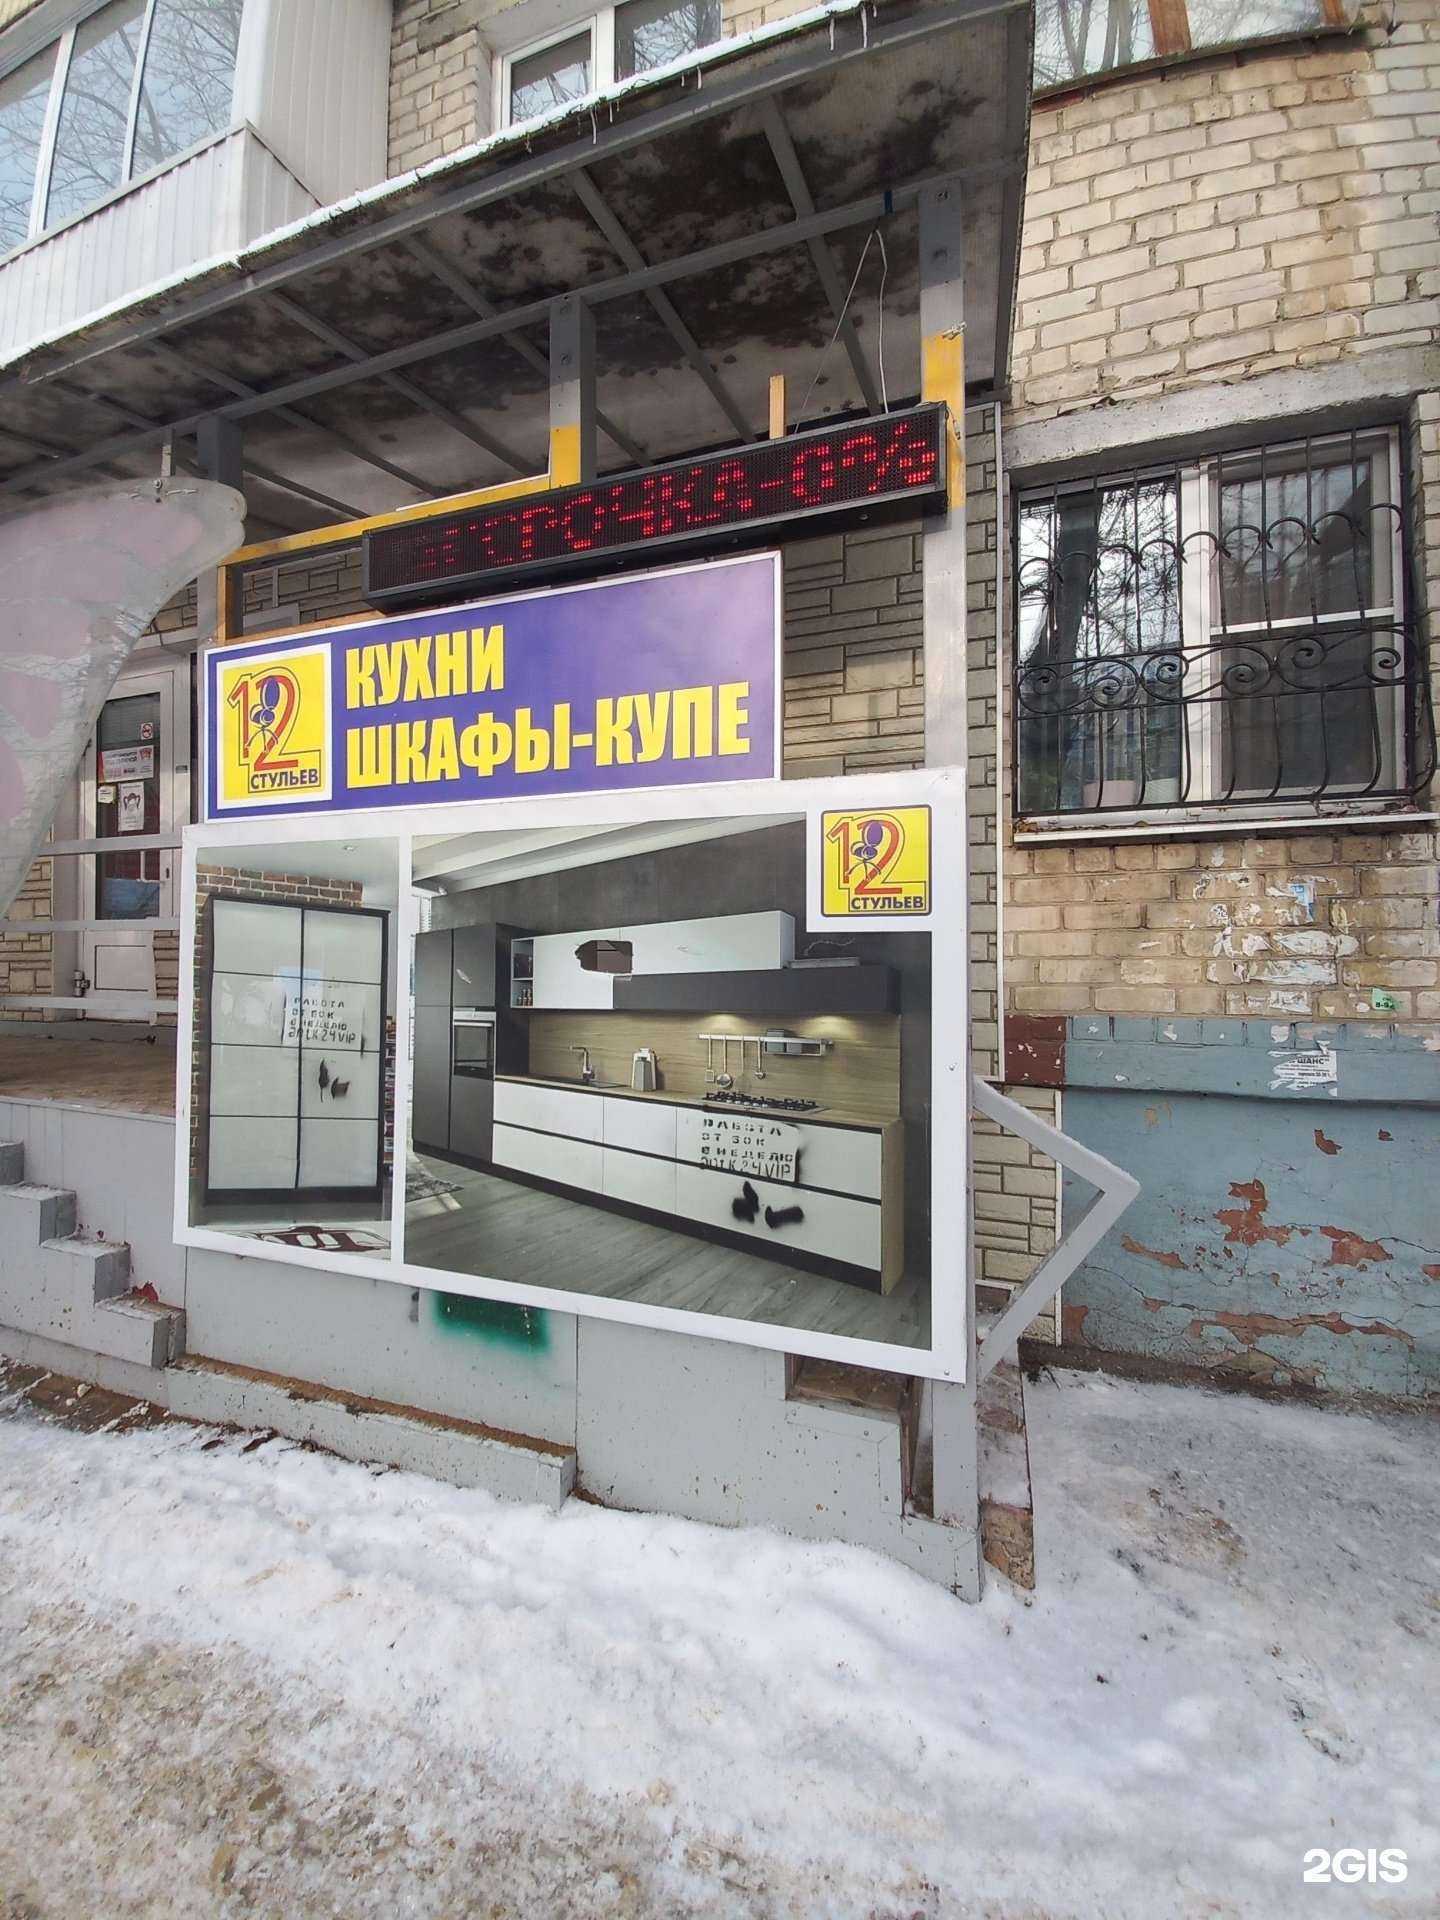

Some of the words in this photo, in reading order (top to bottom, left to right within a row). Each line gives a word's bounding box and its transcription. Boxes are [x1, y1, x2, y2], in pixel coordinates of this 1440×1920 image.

[346, 625, 505, 709] КУХНИ
[227, 666, 301, 772] 12
[346, 680, 750, 789] ШКАФЫ-КУПЕ
[250, 768, 319, 790] СТУЛЬЕВ
[826, 813, 905, 895] 12
[850, 895, 924, 909] СТУЛЬЕВ
